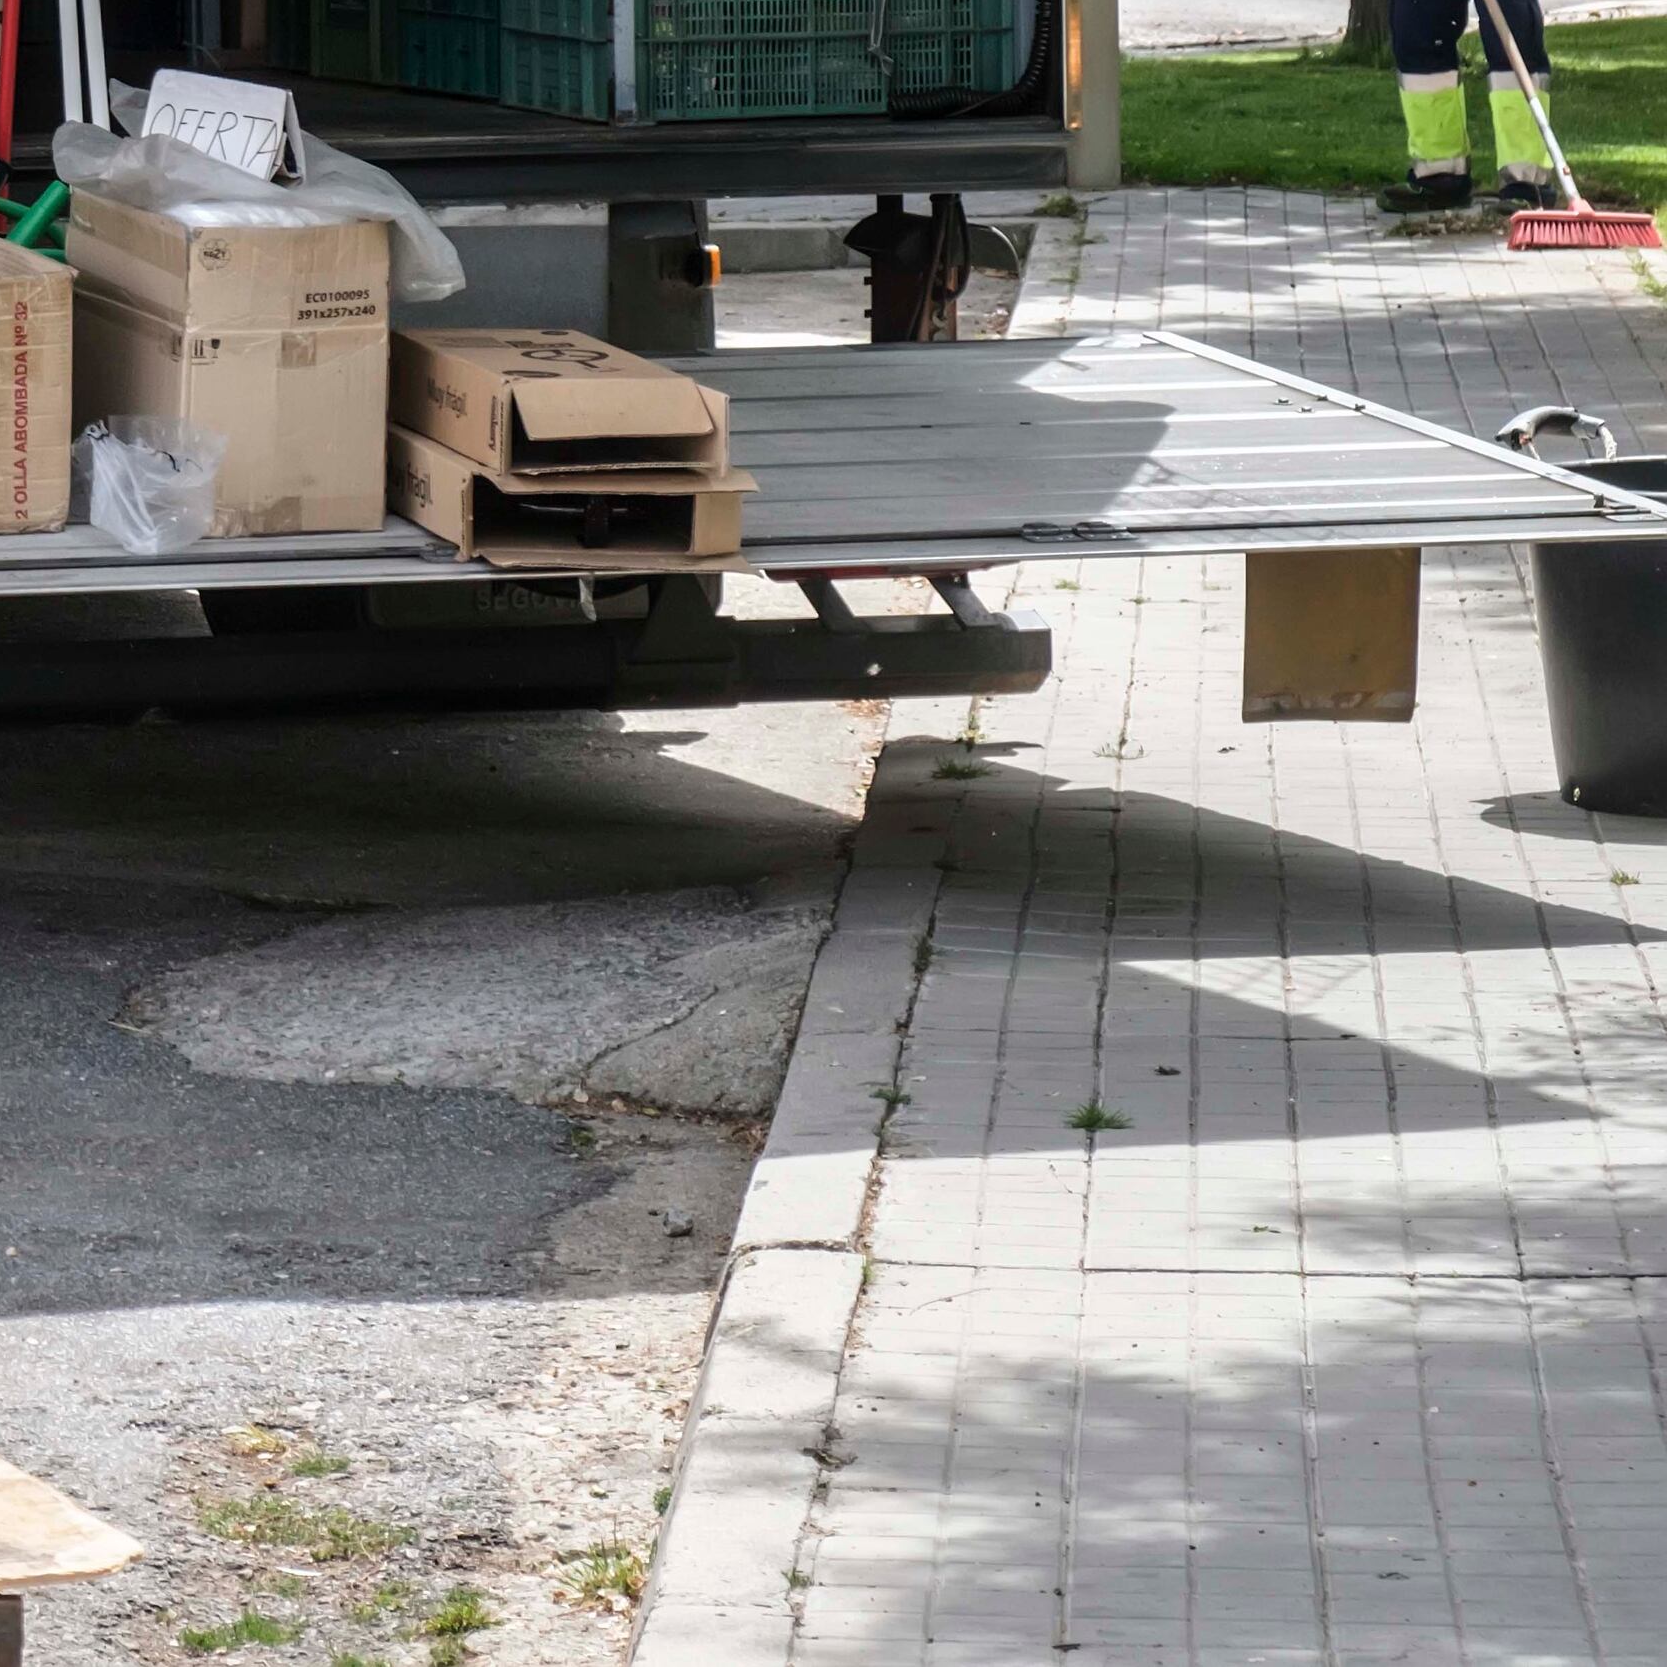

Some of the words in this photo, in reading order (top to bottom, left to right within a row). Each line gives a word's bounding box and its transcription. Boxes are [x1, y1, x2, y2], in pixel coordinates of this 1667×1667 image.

[305, 289, 370, 304] EC0100095
[14, 301, 28, 321] 32
[297, 304, 376, 320] 391x257x240
[14, 351, 28, 453] ABOMBADA
[14, 457, 28, 504] OLLA
[15, 509, 28, 520] 2
